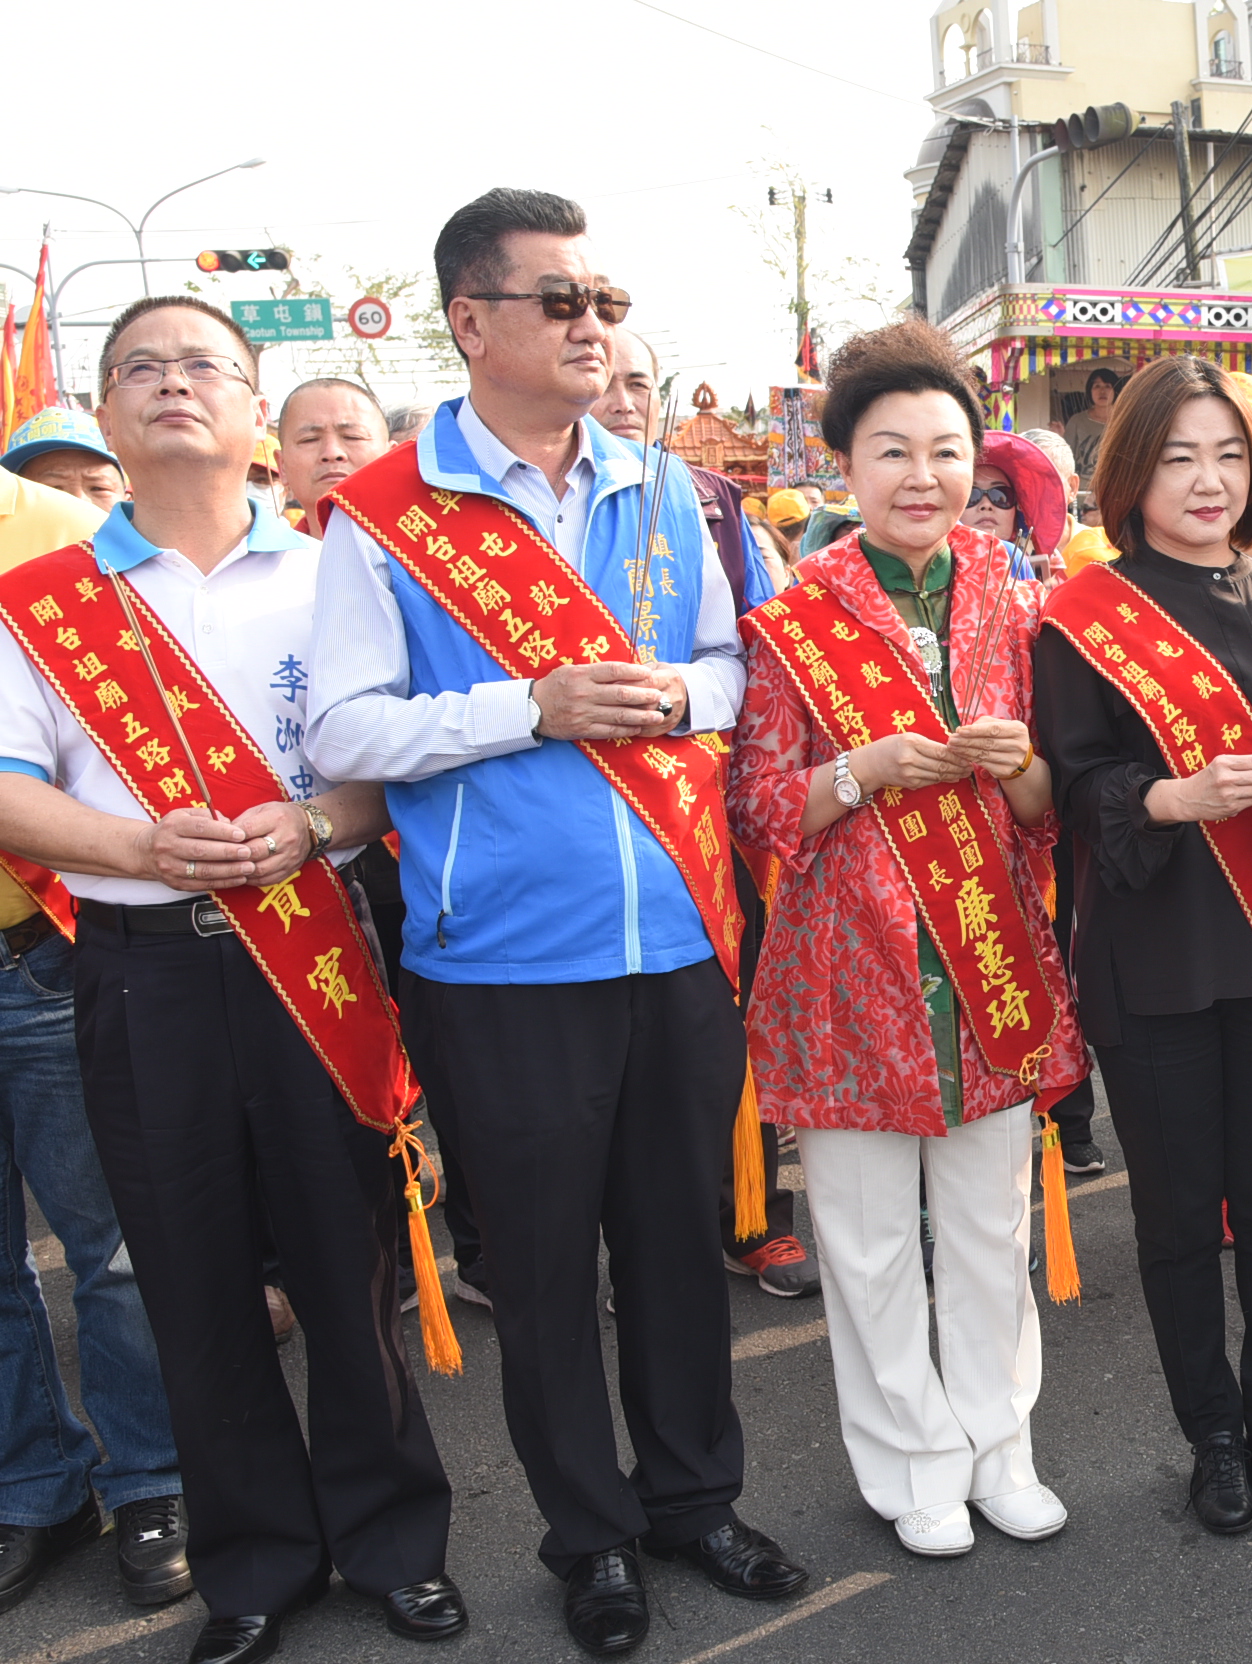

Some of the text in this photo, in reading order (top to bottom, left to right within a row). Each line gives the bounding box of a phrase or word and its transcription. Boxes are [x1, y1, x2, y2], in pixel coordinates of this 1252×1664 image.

[240, 303, 324, 323] 草屯鎮
[279, 325, 325, 339] Township
[358, 310, 383, 326] 60
[396, 504, 583, 668] 開台祖廟五路
[1115, 602, 1243, 750] 草屯敦和
[642, 743, 697, 816] 鎮長
[898, 809, 955, 892] 團長
[937, 788, 985, 873] 顧問團
